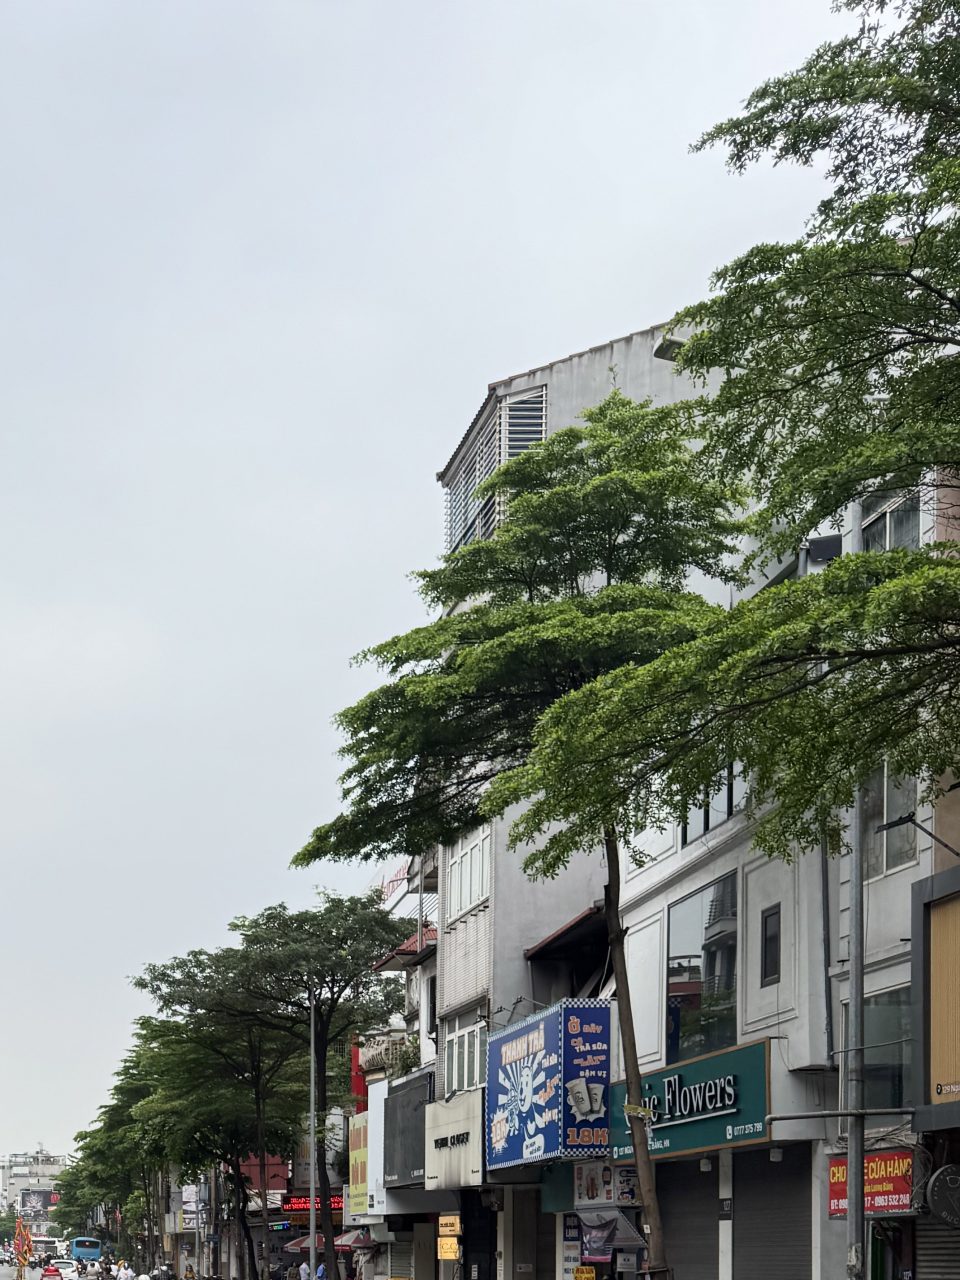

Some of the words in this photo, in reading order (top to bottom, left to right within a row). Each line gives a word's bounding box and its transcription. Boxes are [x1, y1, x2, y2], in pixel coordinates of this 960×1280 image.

[663, 1074, 736, 1119] Flowers
[567, 1128, 609, 1146] 18K
[829, 1165, 847, 1184] CHO
[868, 1157, 887, 1181] CỬA
[887, 1156, 912, 1178] HÀNG
